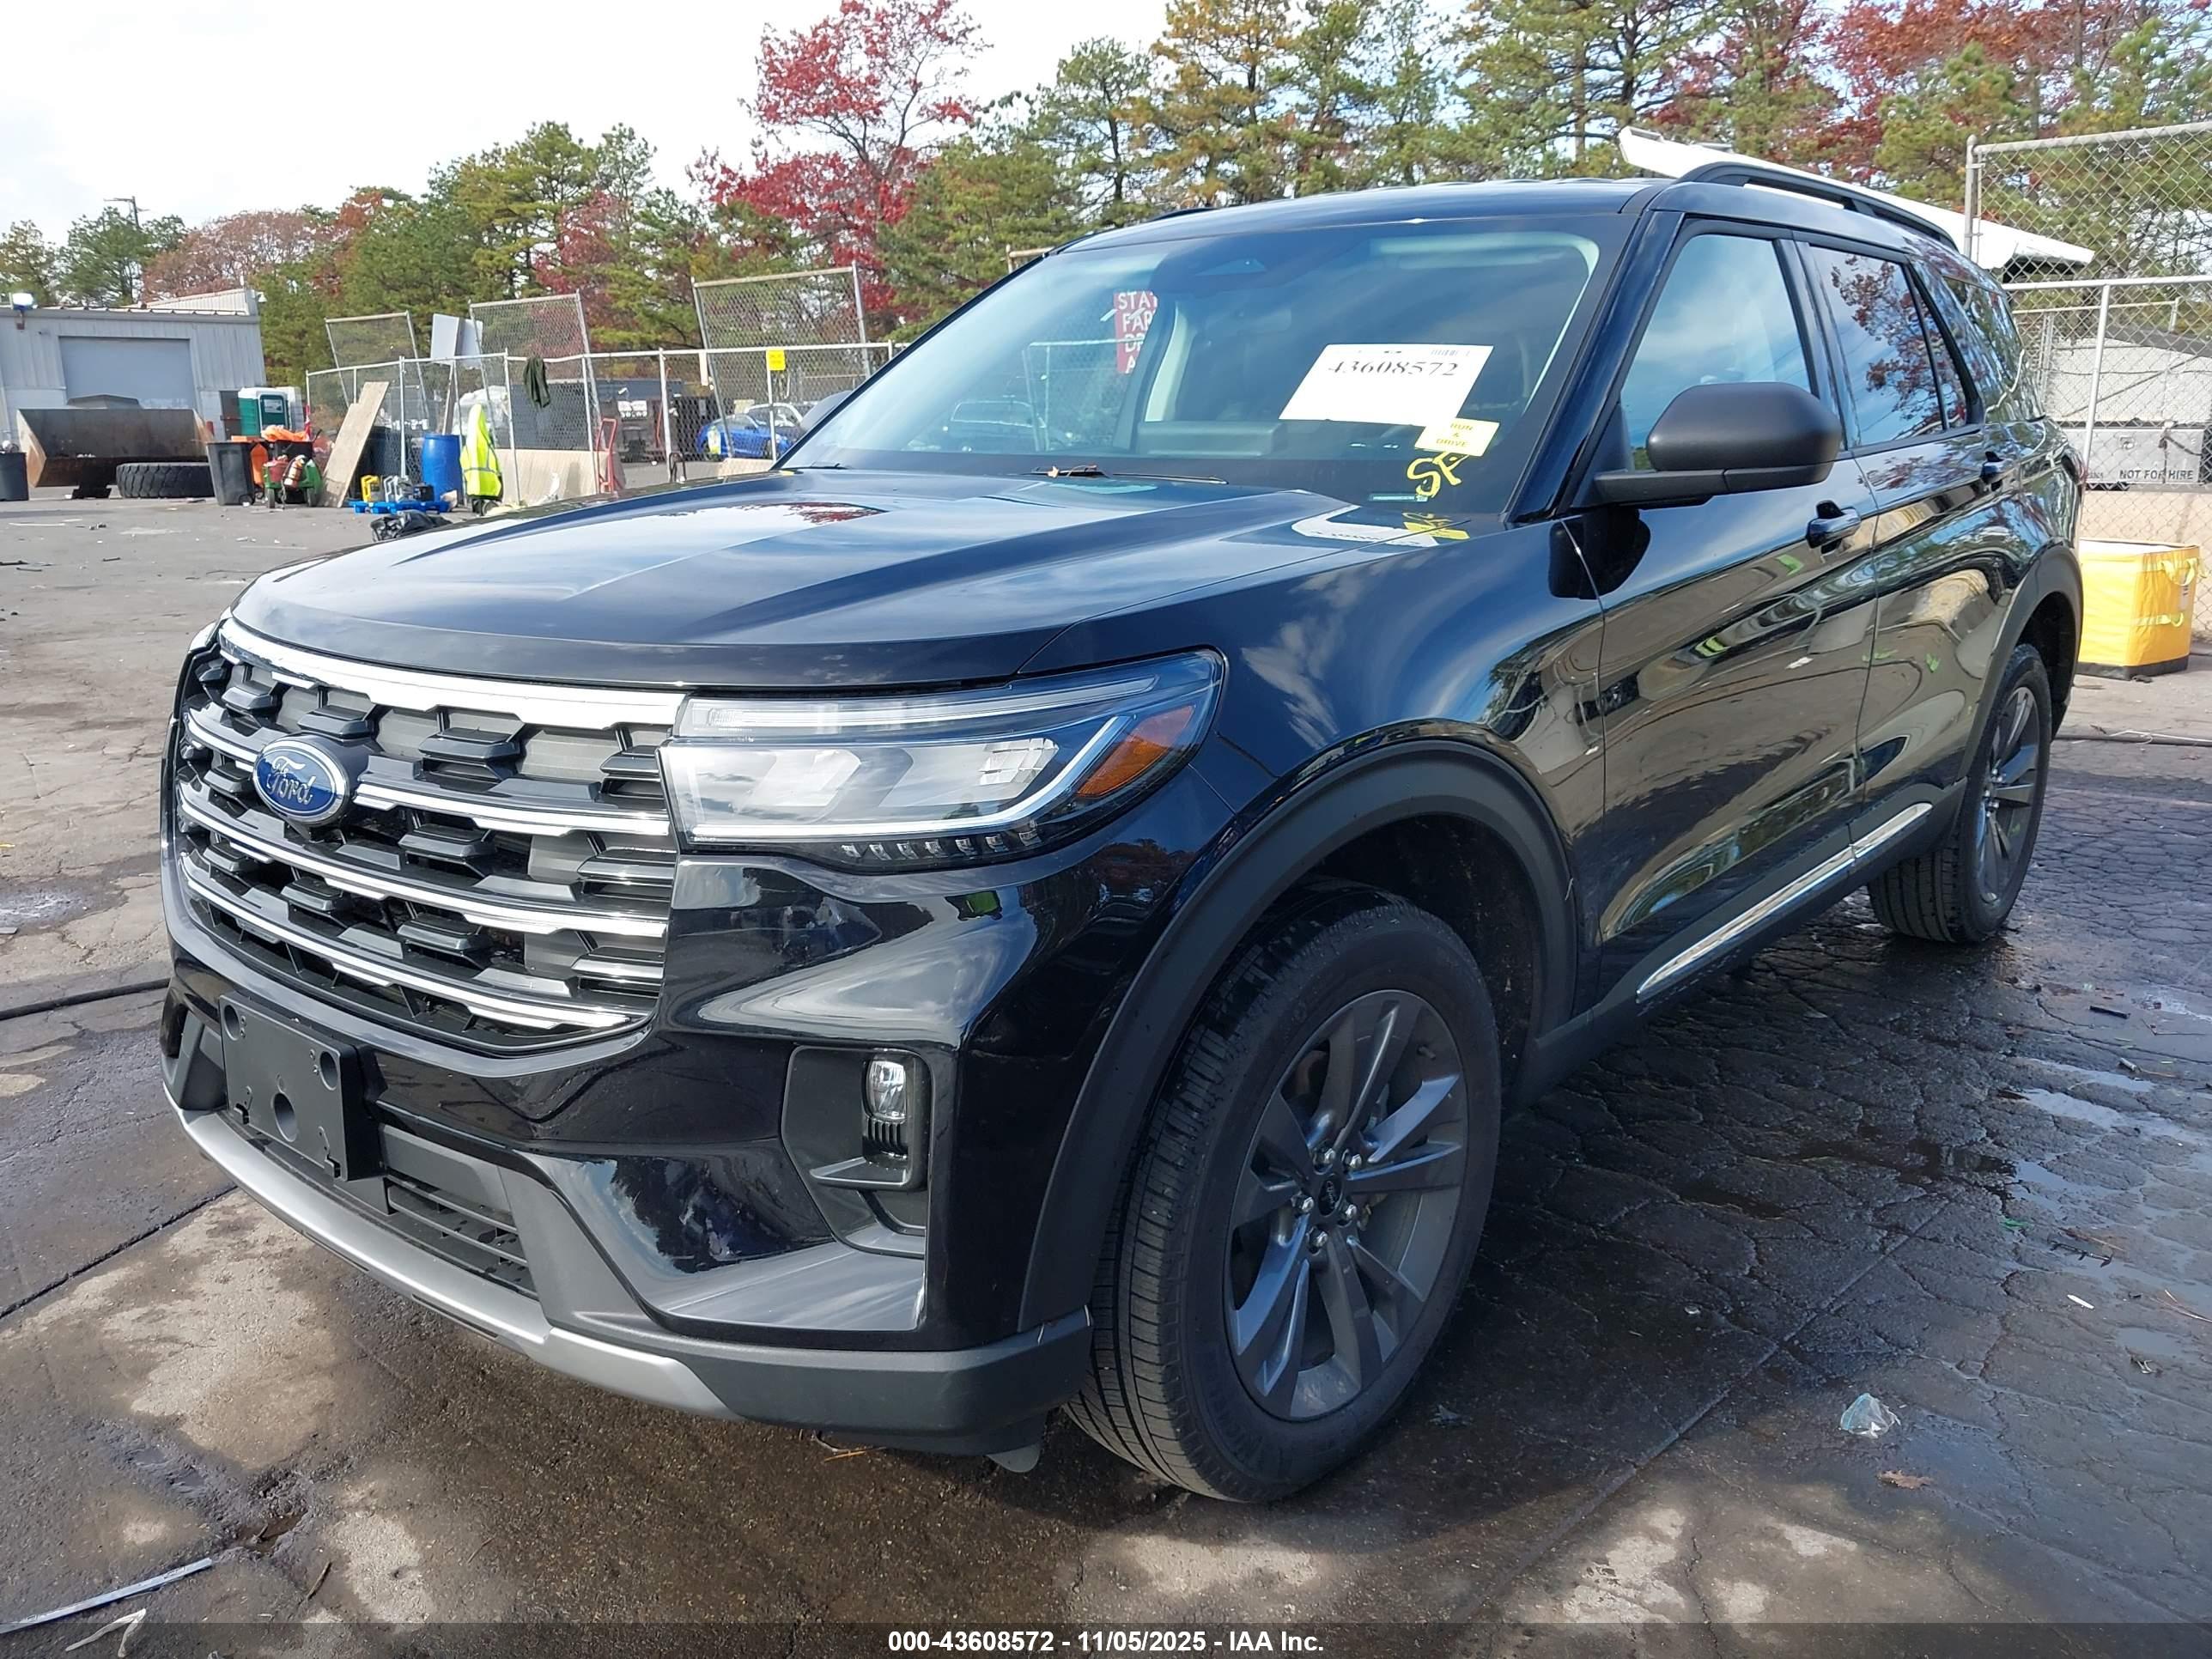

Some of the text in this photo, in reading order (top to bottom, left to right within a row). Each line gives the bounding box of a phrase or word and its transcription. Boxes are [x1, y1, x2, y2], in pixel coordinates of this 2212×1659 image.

[1328, 360, 1458, 376] 43608572
[1436, 438, 1467, 447] DRIVE
[2119, 470, 2194, 480] NOT FOR HIRE
[266, 756, 316, 805] Ford
